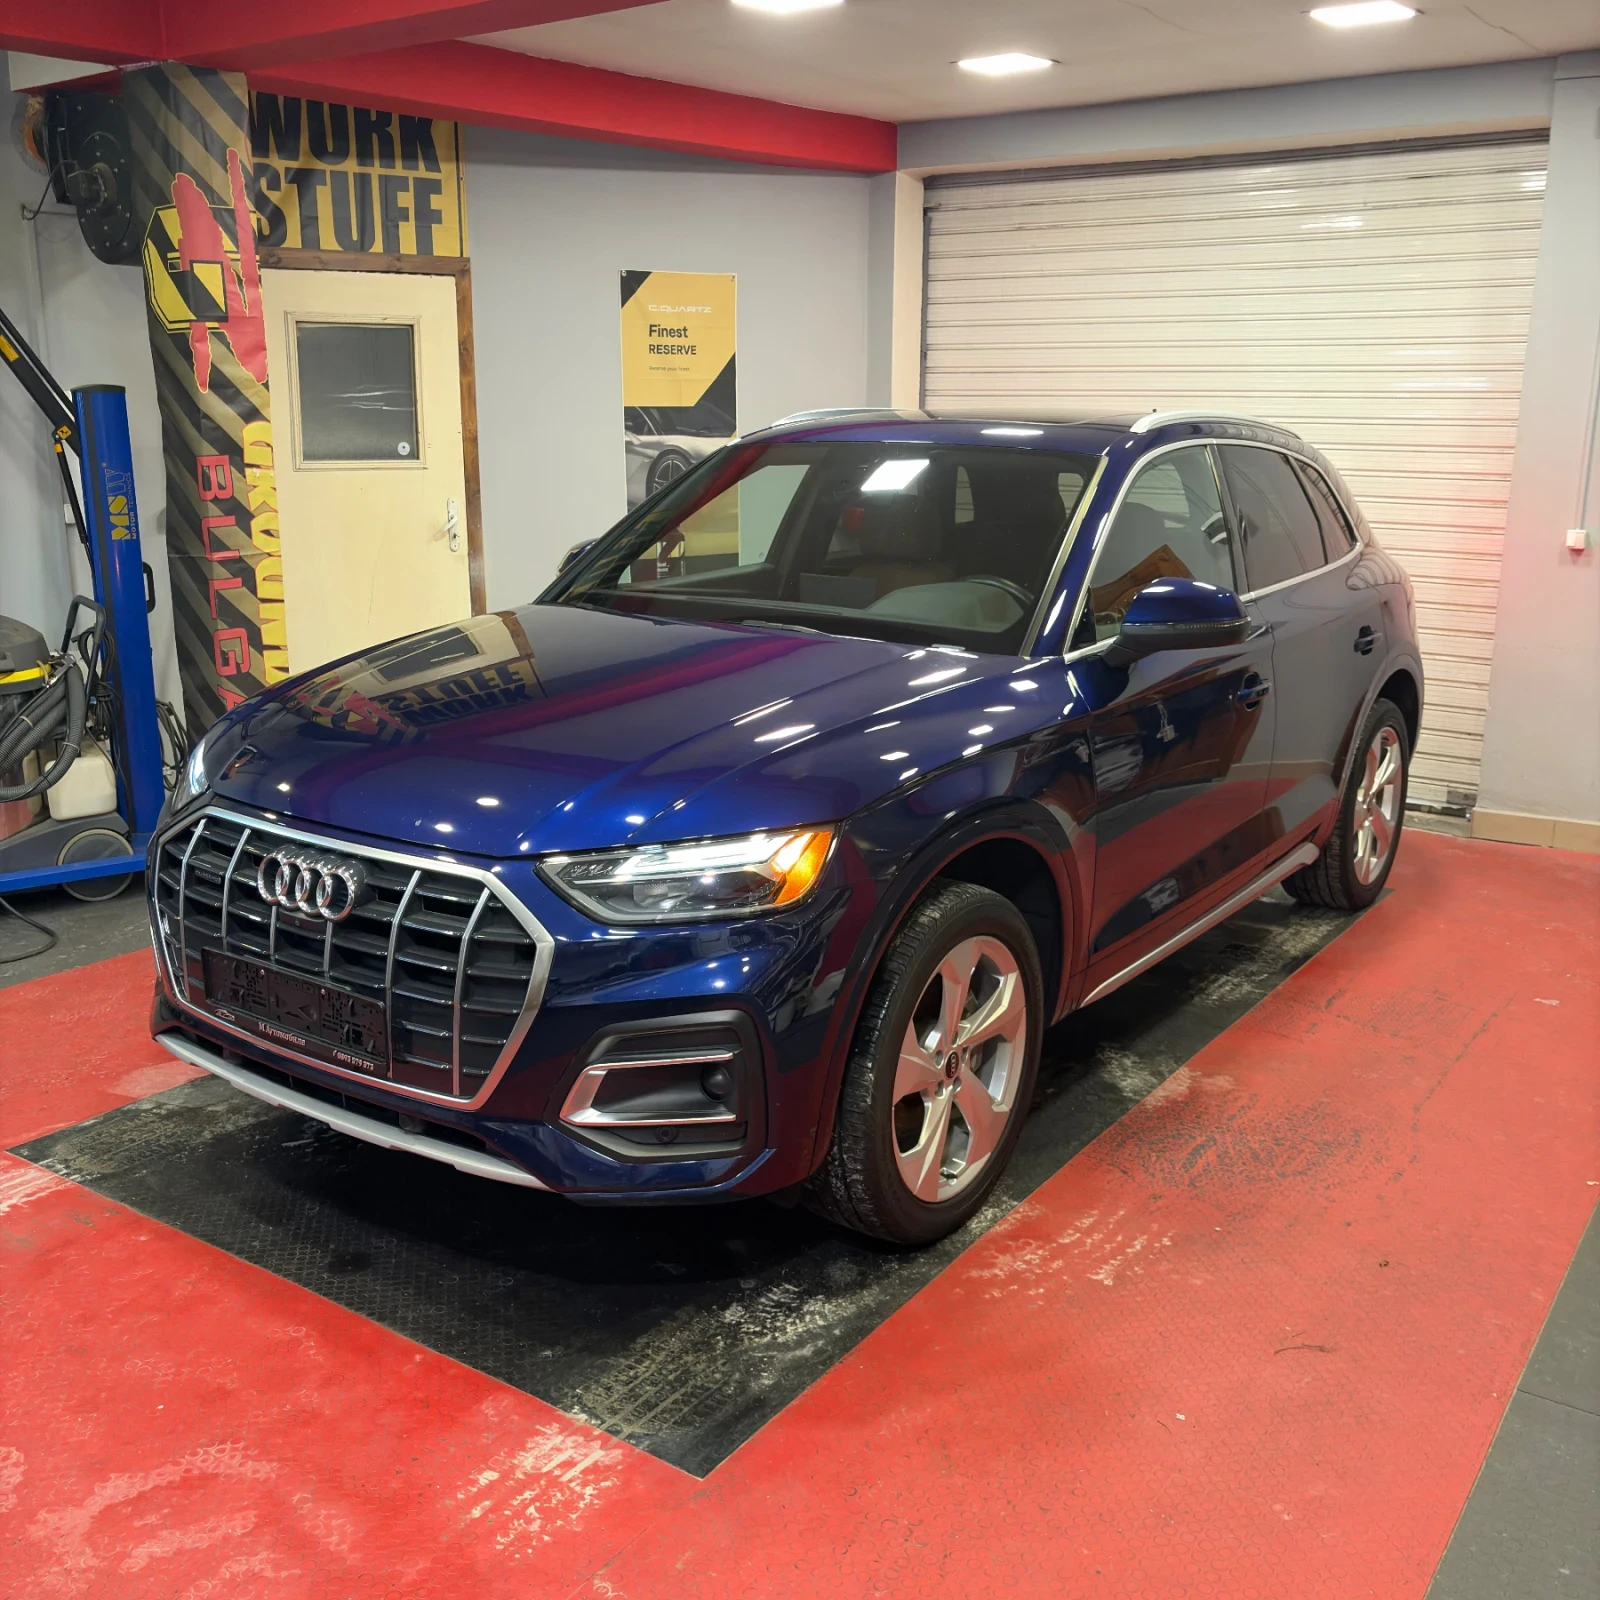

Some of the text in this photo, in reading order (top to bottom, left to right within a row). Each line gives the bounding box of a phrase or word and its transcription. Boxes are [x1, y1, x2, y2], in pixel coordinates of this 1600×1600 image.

[249, 91, 442, 173] WORK
[253, 162, 443, 255] STUFF
[648, 323, 688, 338] Finest
[648, 343, 697, 355] RESERVE
[129, 512, 137, 539] MOTOR
